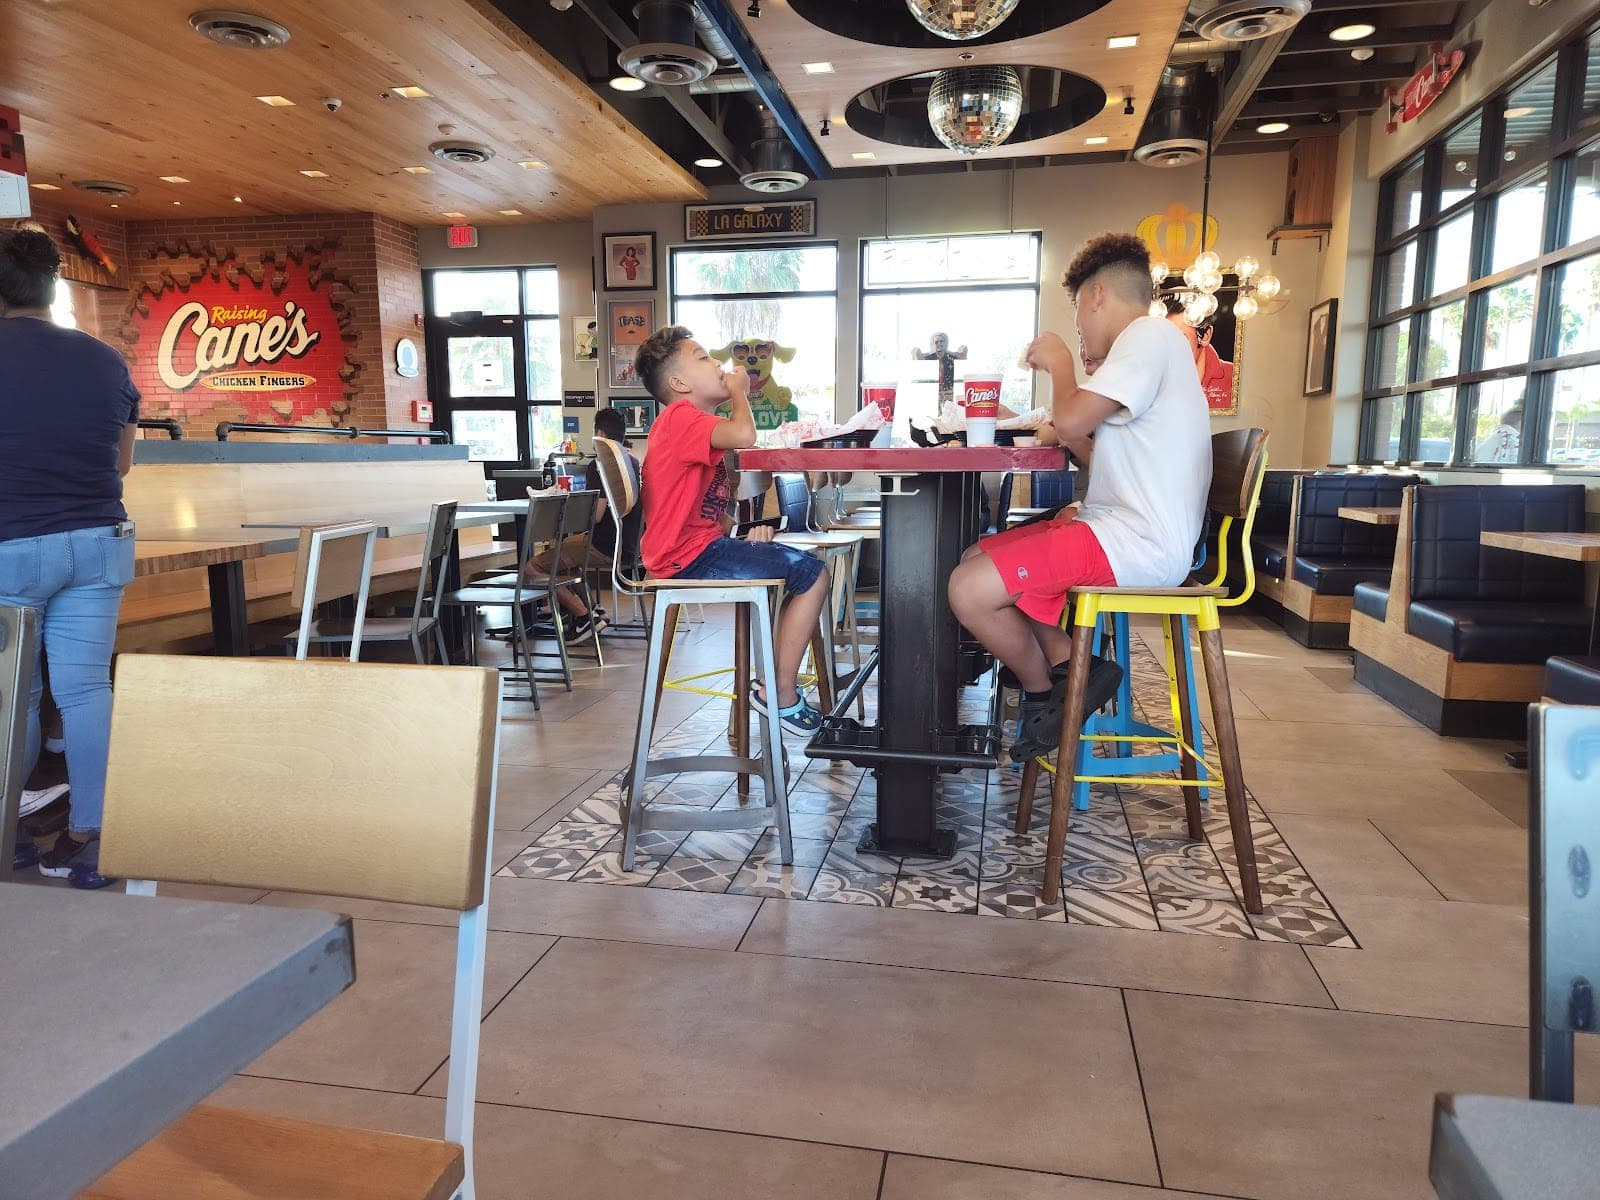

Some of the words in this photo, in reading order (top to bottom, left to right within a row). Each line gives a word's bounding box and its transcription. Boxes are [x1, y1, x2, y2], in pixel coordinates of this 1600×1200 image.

[714, 214, 730, 230] LA
[734, 212, 783, 229] GALAXY
[210, 304, 268, 324] Raising
[157, 301, 320, 390] Cane's
[212, 376, 256, 386] CHICKEN
[259, 375, 305, 386] FINGERS
[965, 387, 998, 407] Cane's
